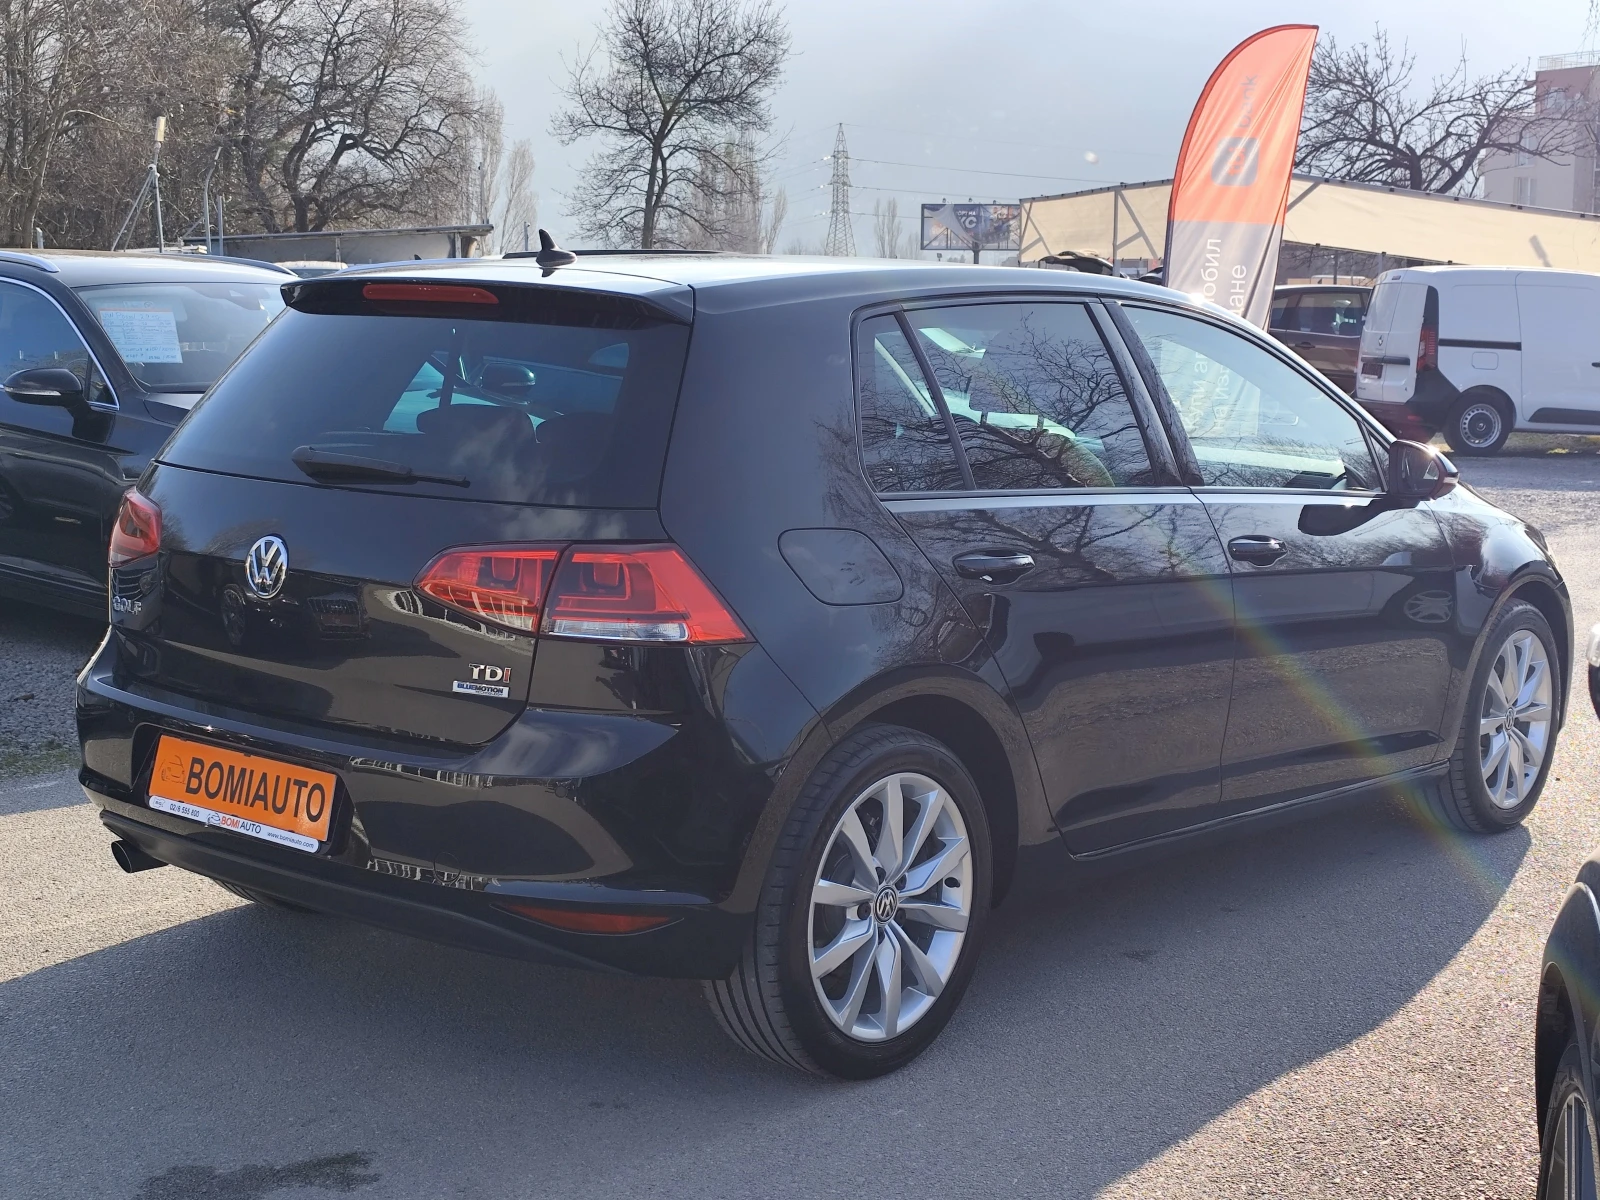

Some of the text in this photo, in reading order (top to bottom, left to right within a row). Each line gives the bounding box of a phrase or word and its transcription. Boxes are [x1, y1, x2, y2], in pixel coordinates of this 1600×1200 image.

[112, 595, 142, 615] GOLF
[468, 663, 512, 684] TDI
[456, 682, 504, 694] BLUEMOTION
[185, 756, 326, 823] BOMIAUTO
[220, 815, 262, 834] BOMI AUTO
[266, 830, 315, 849] www.bomiauto.com
